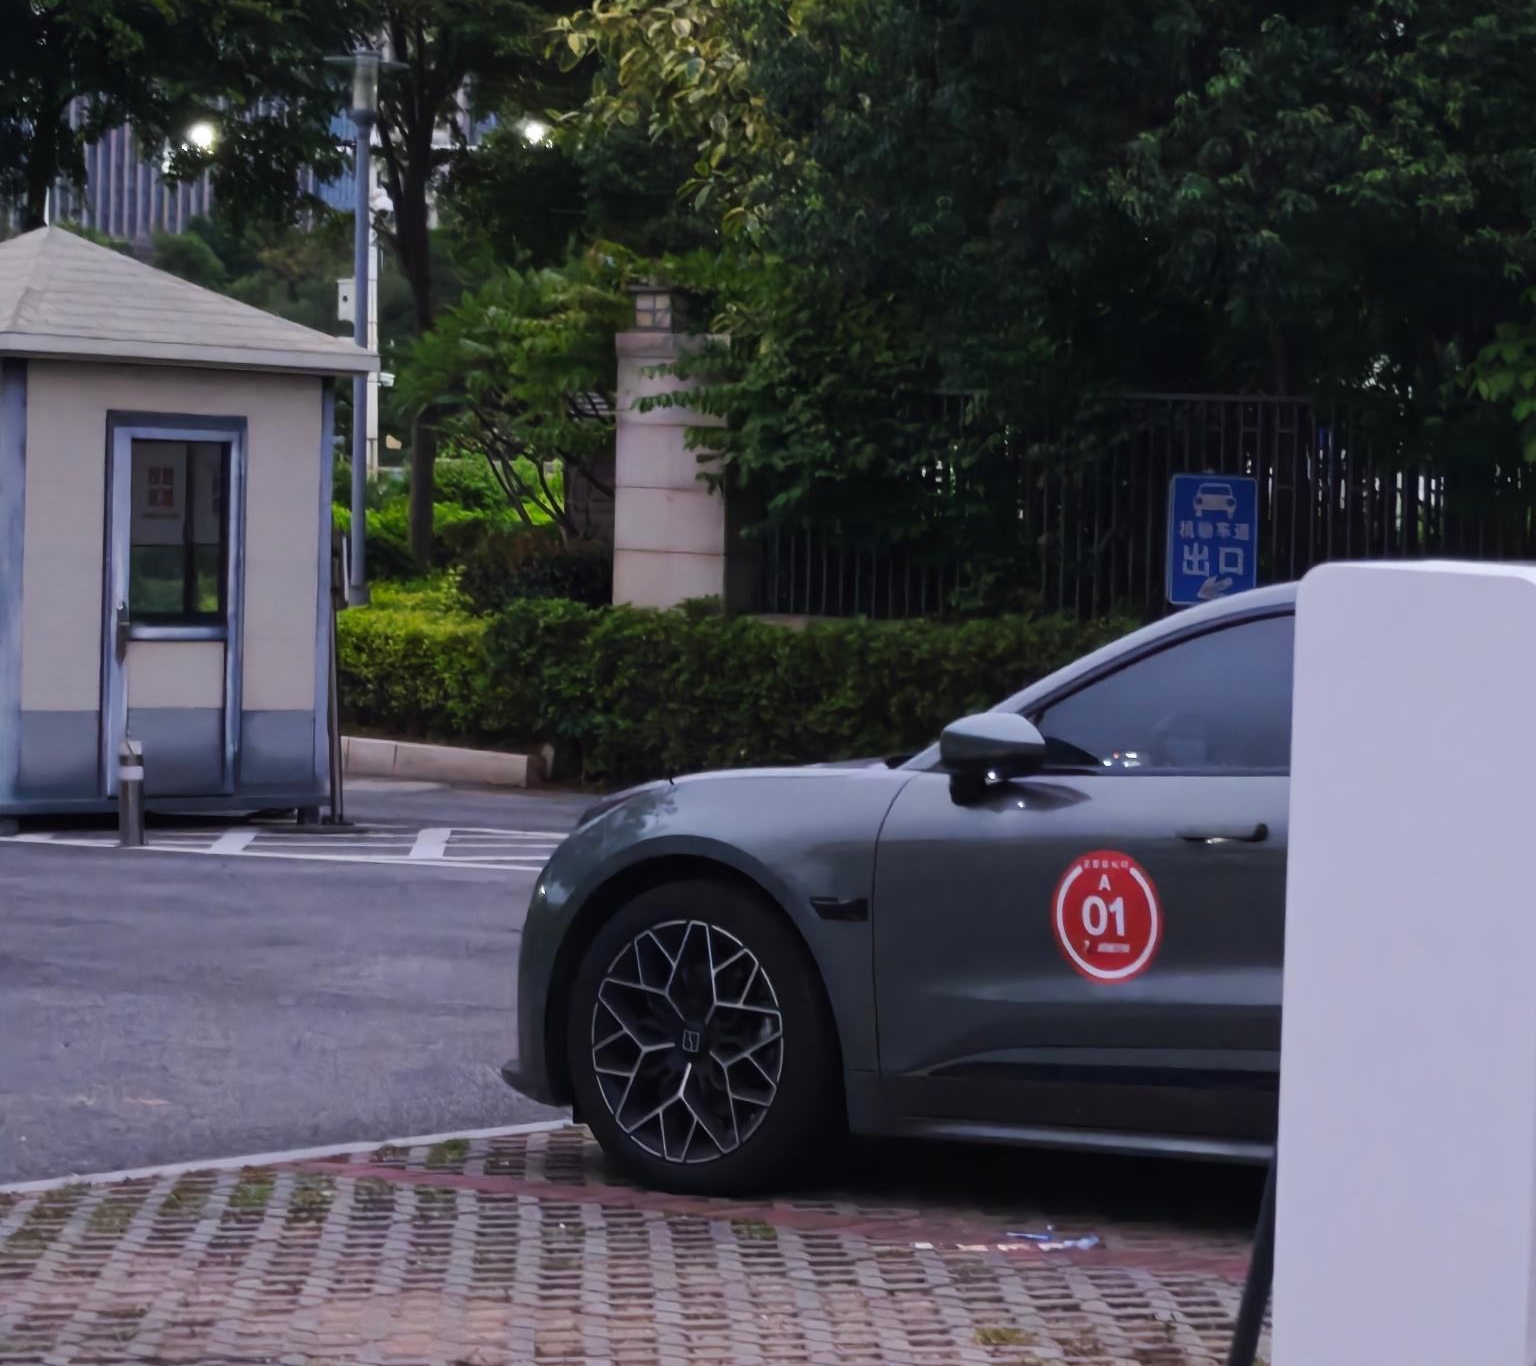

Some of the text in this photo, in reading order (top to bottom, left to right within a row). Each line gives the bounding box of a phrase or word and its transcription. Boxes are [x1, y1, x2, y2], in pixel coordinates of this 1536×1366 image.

[1182, 541, 1244, 578] 出口
[1098, 873, 1111, 891] A
[1081, 895, 1125, 937] 01
